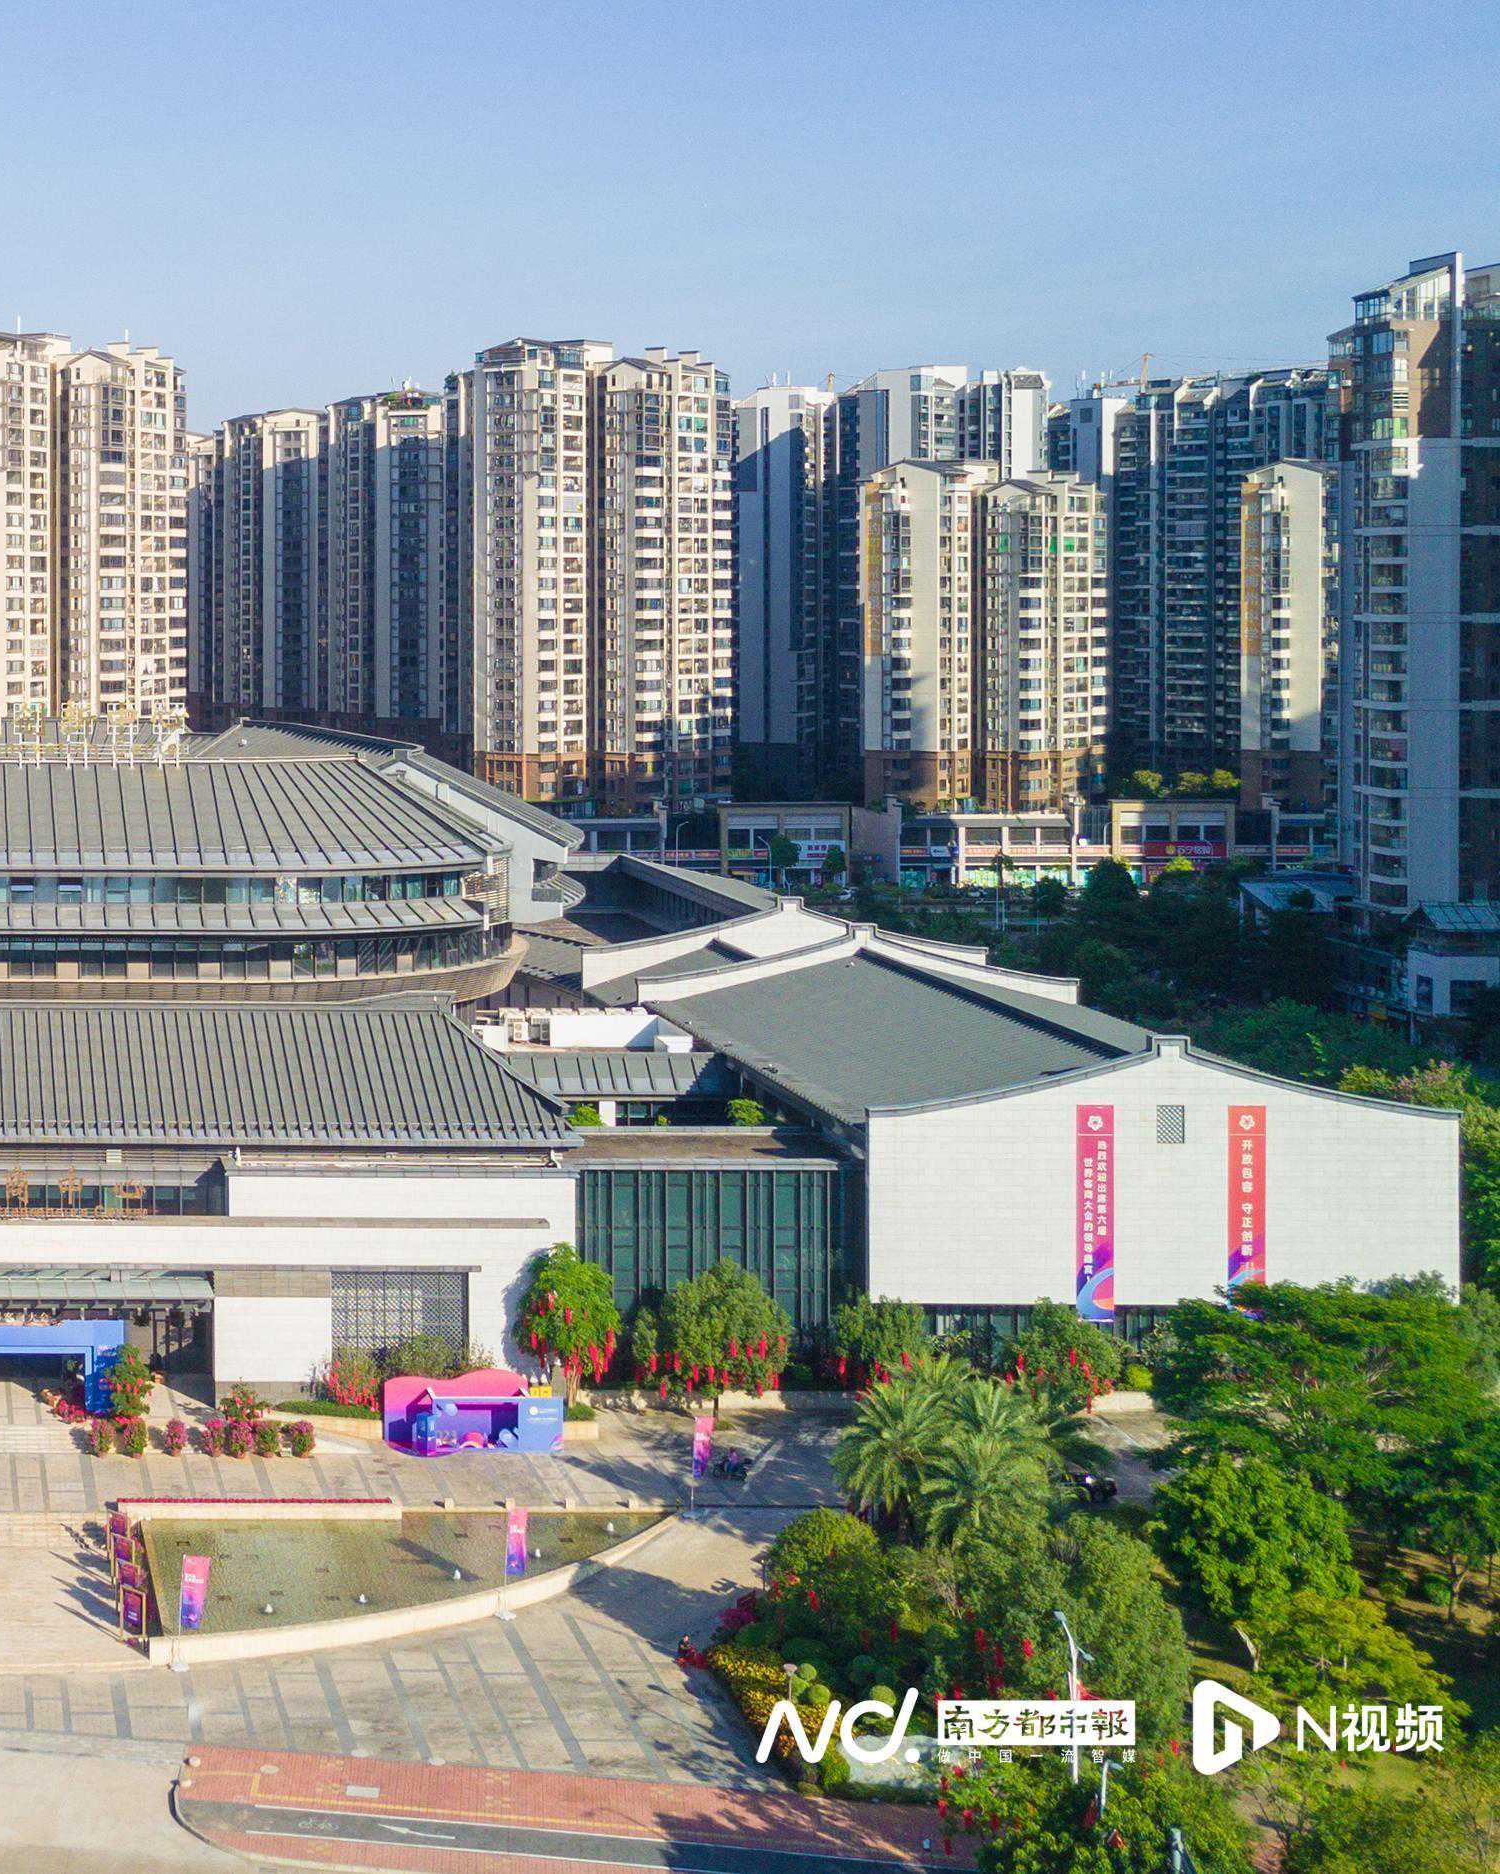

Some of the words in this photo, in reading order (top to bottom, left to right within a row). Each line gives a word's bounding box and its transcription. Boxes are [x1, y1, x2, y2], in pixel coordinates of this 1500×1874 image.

[1241, 1139, 1254, 1194] 开放包容
[1241, 1202, 1254, 1257] 守正创新
